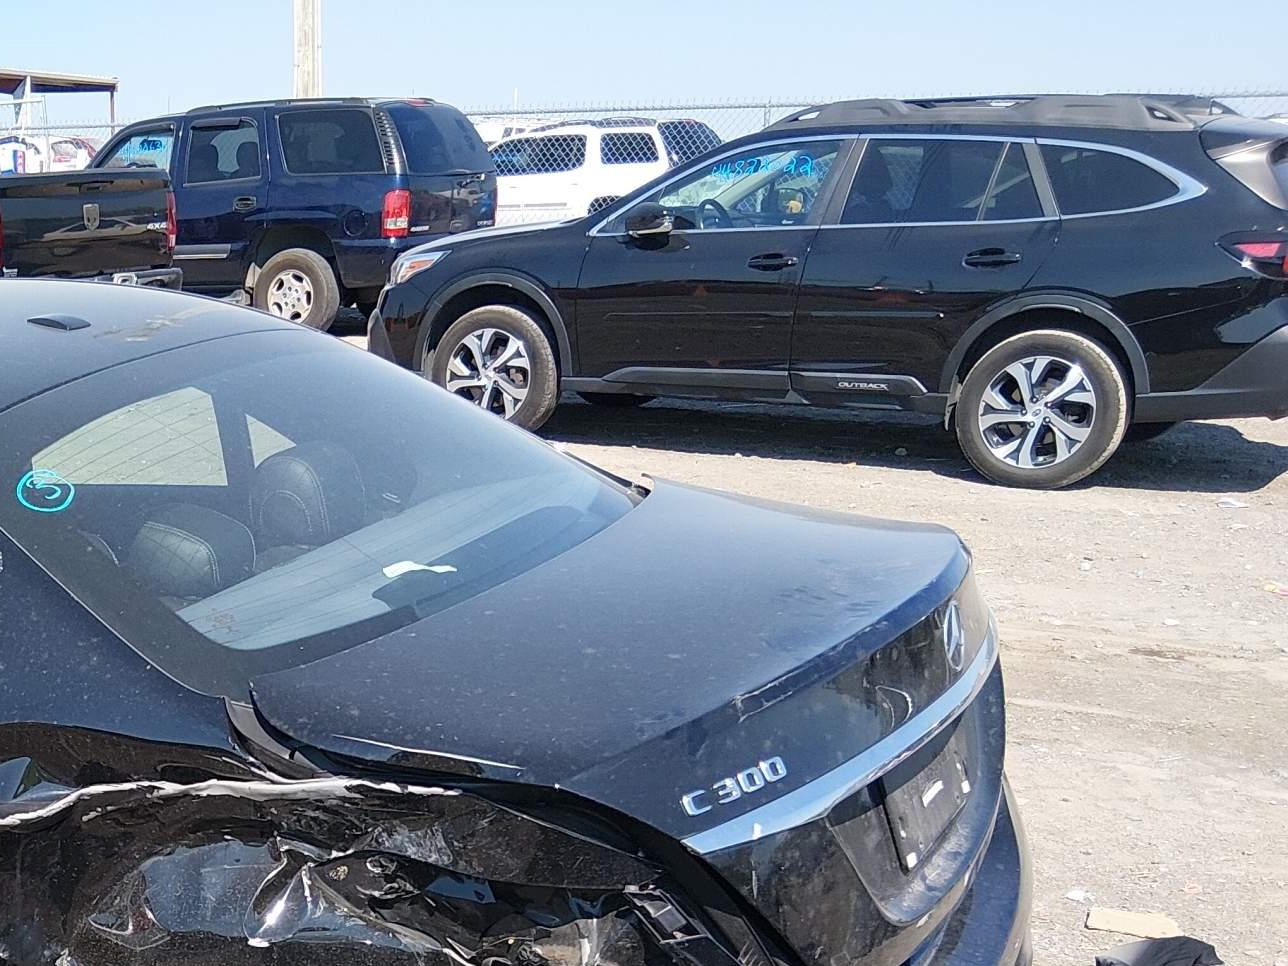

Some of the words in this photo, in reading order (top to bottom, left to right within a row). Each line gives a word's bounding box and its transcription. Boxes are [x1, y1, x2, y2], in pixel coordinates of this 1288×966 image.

[838, 381, 889, 391] OUTBACK
[679, 790, 712, 816] C
[712, 756, 787, 804] 300
